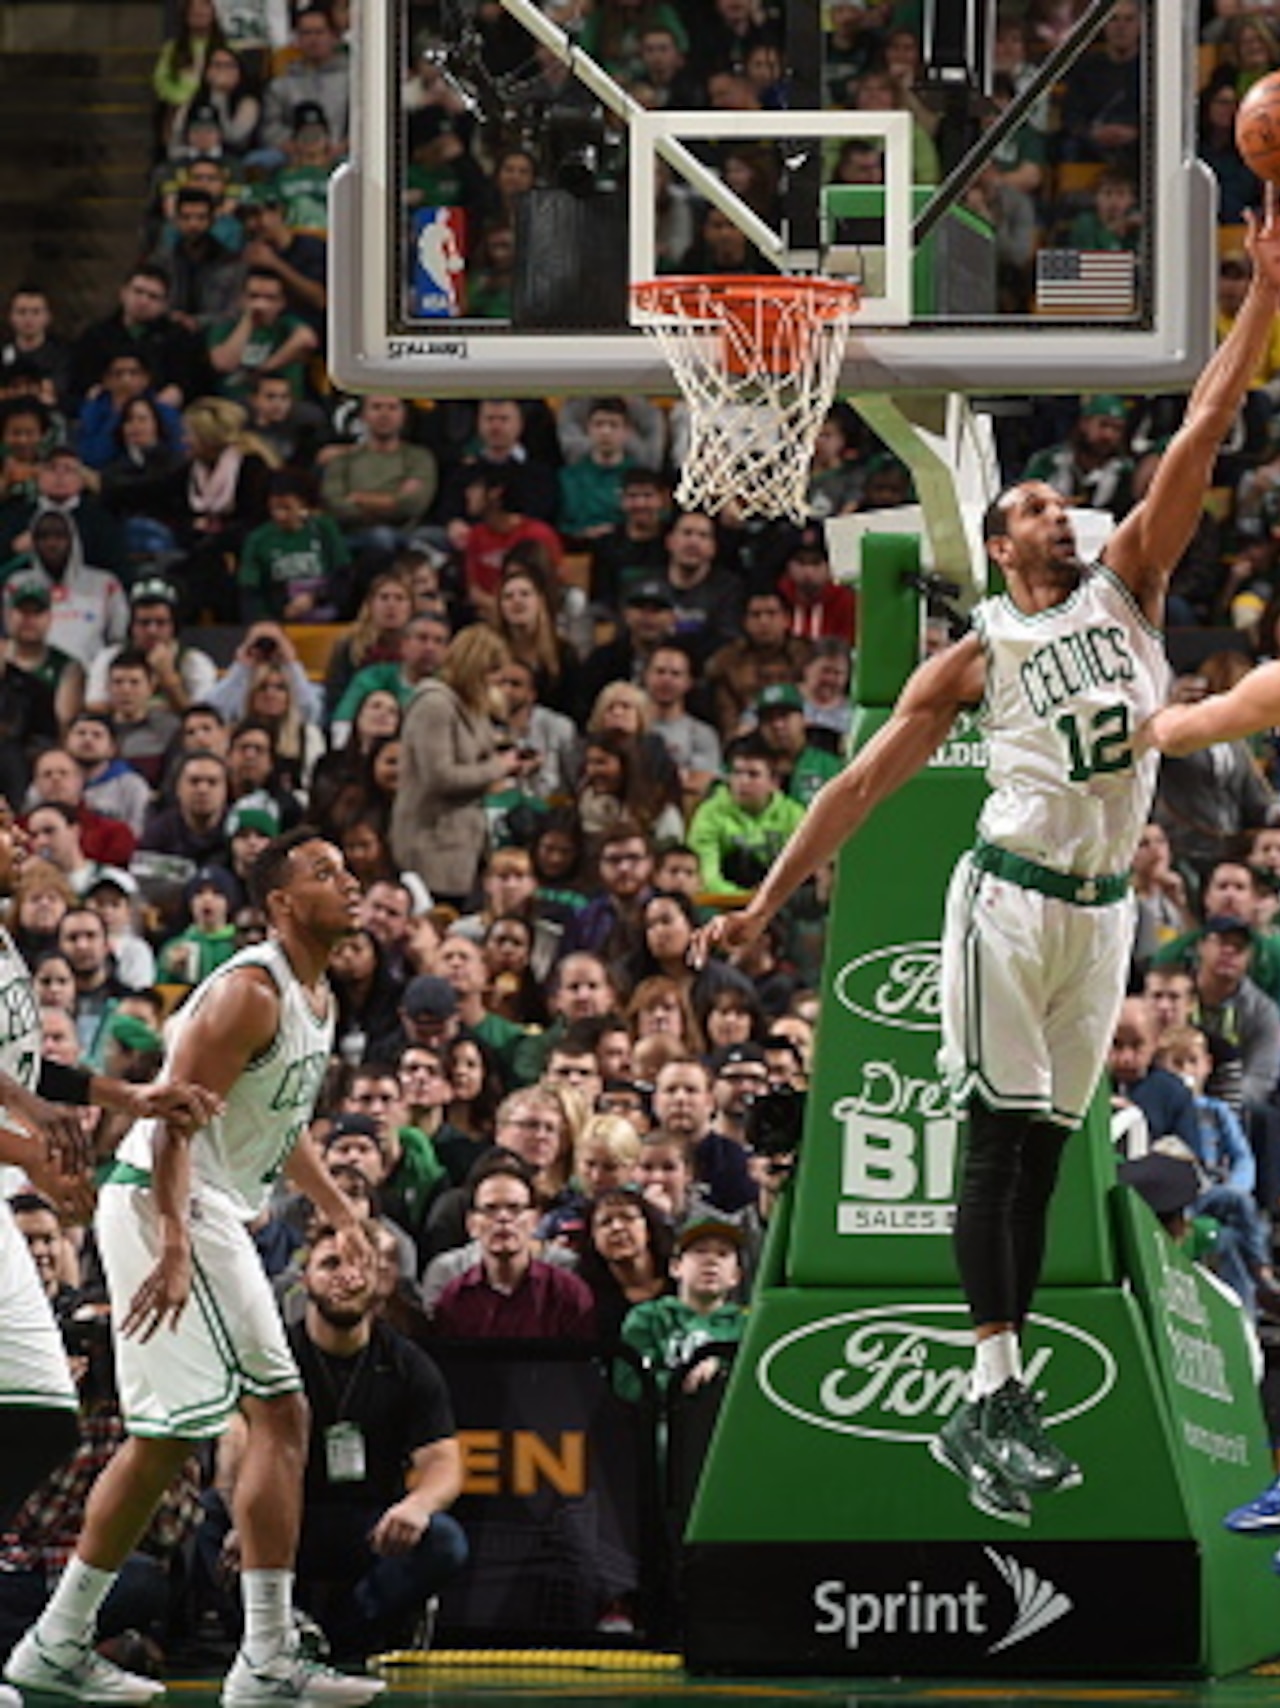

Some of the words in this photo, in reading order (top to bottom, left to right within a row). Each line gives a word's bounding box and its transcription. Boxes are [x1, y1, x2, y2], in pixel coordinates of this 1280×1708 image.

[1020, 627, 1136, 717] CELTICS
[1055, 702, 1133, 781] 12
[855, 1210, 935, 1229] SALES
[813, 1580, 989, 1649] Sprint
